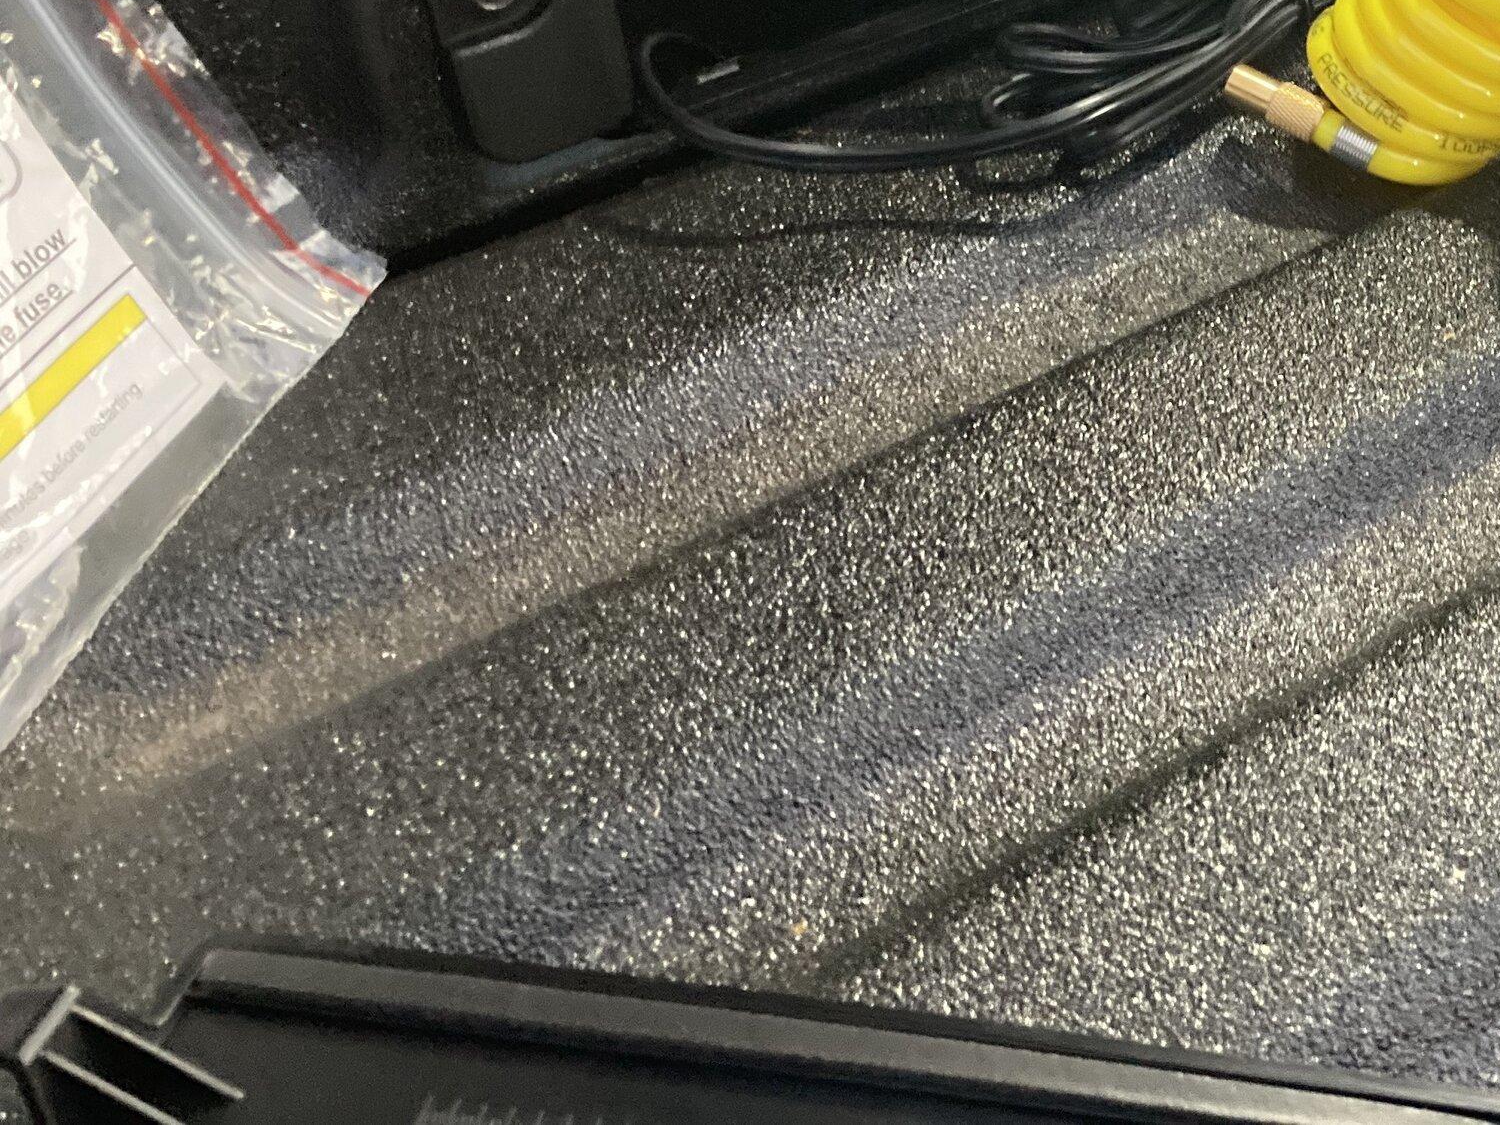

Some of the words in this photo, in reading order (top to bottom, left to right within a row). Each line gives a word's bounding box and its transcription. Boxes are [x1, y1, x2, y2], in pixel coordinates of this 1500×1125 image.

[1317, 52, 1403, 133] PRESSURE
[10, 228, 66, 280] blow
[44, 439, 86, 483] before
[85, 383, 143, 442] restarting
